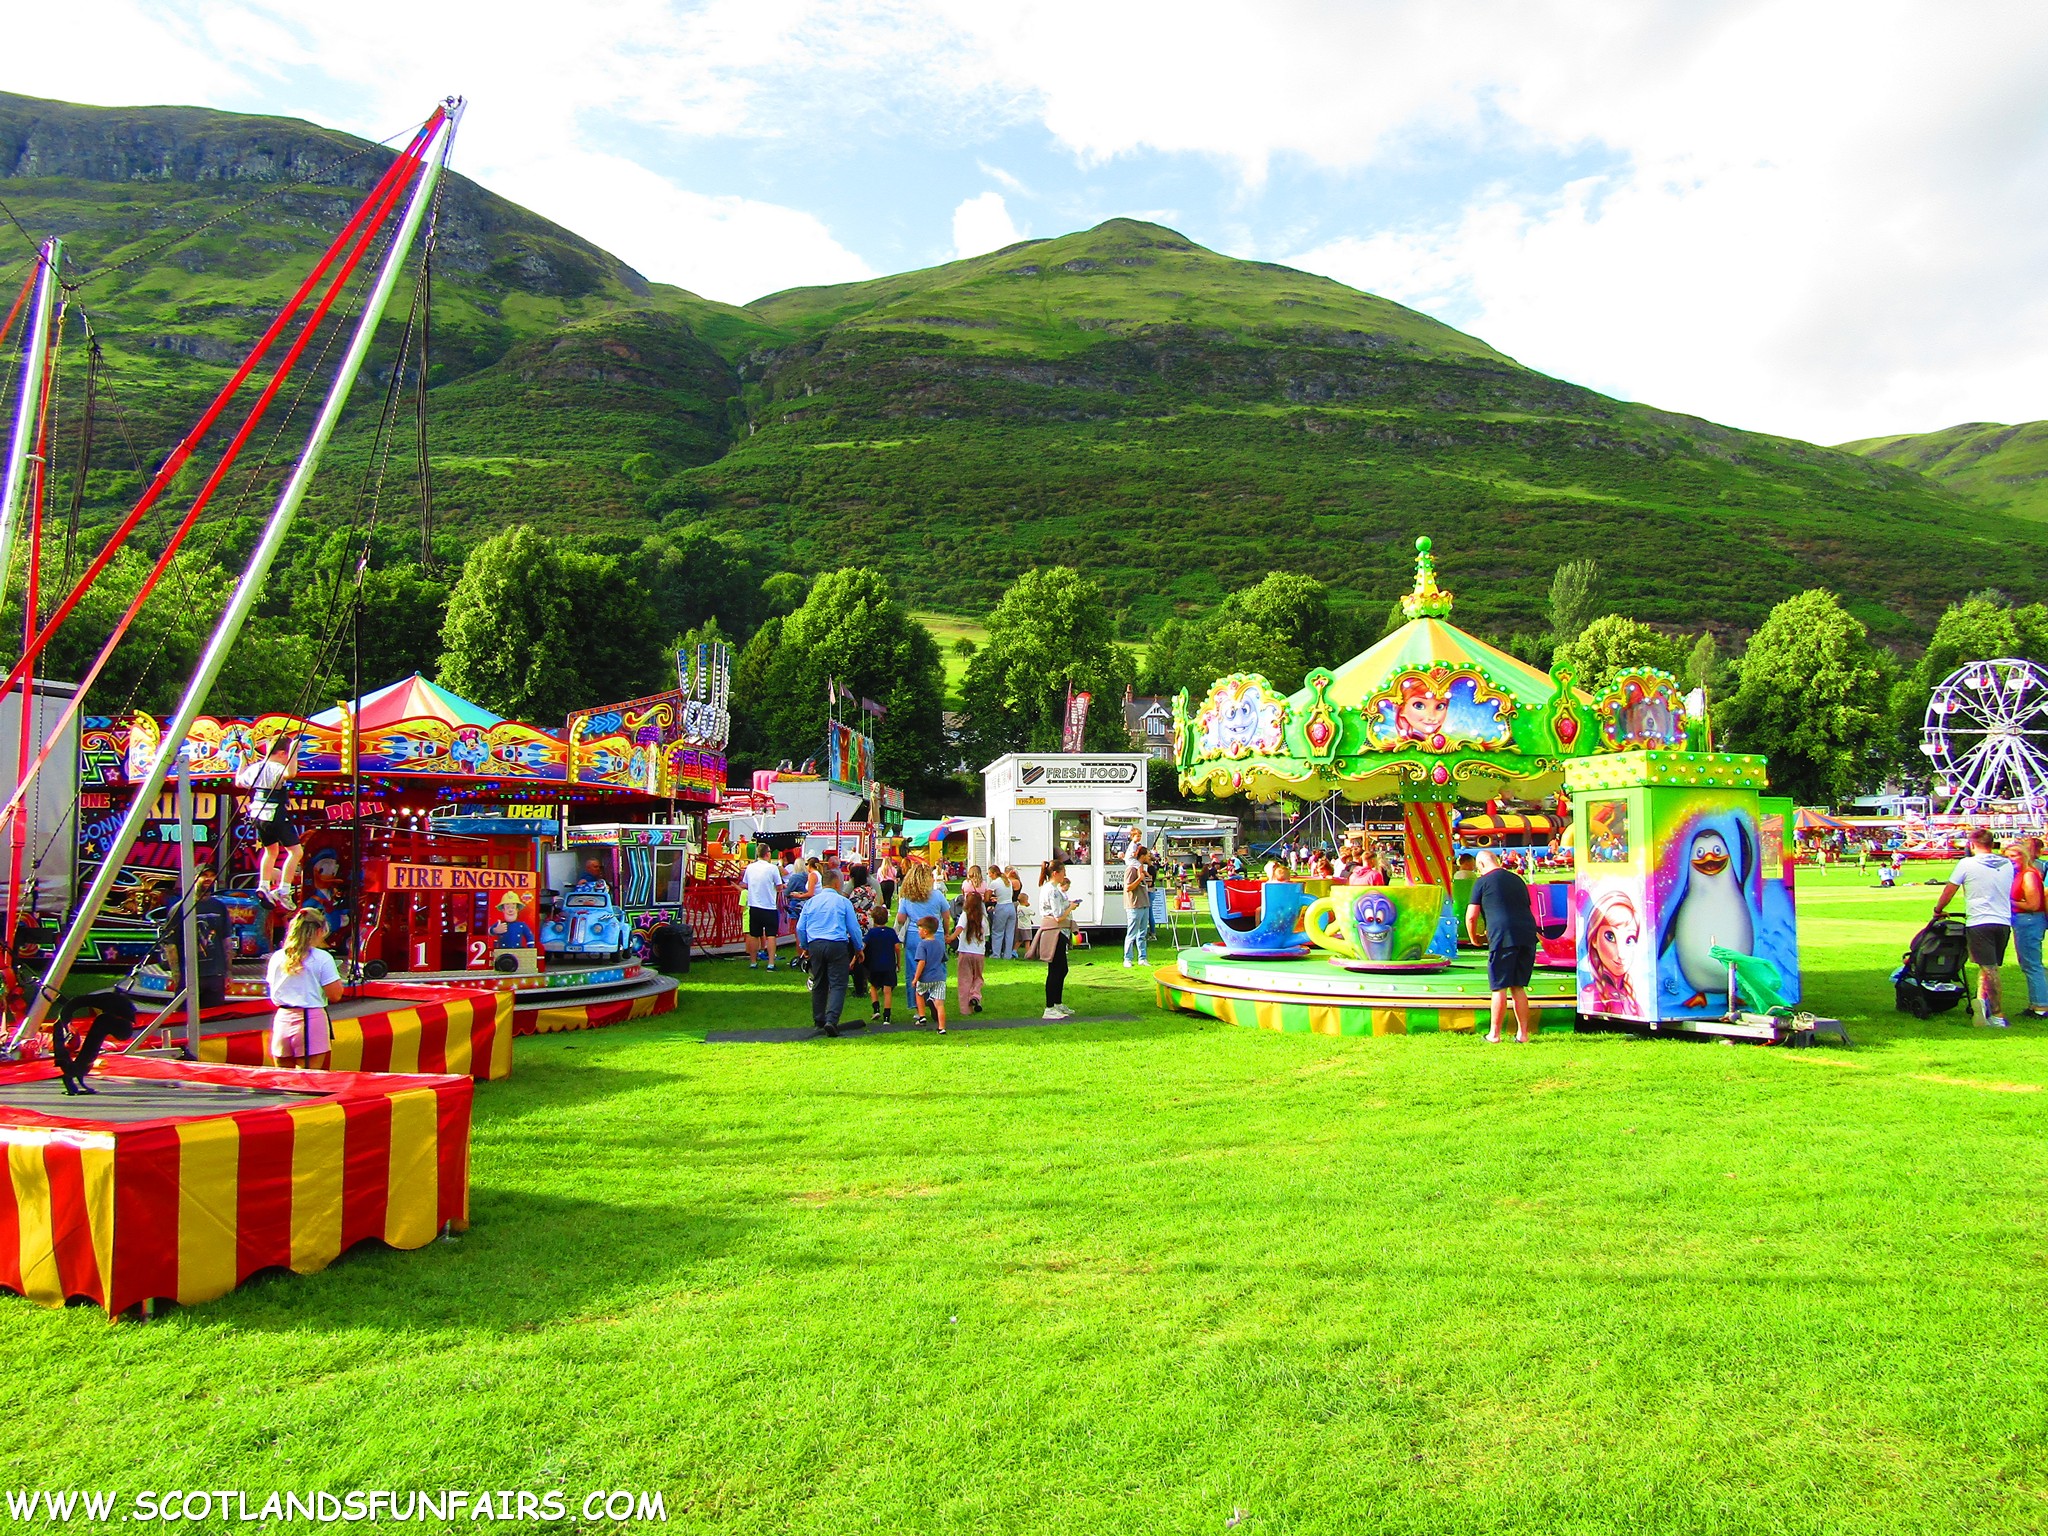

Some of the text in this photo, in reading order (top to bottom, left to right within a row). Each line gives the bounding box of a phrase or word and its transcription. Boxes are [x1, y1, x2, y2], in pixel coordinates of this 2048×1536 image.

[1046, 768, 1128, 778] FRESH FOOD
[394, 867, 528, 888] FIRE ENGINE
[414, 942, 428, 967] 1
[470, 941, 486, 965] 2
